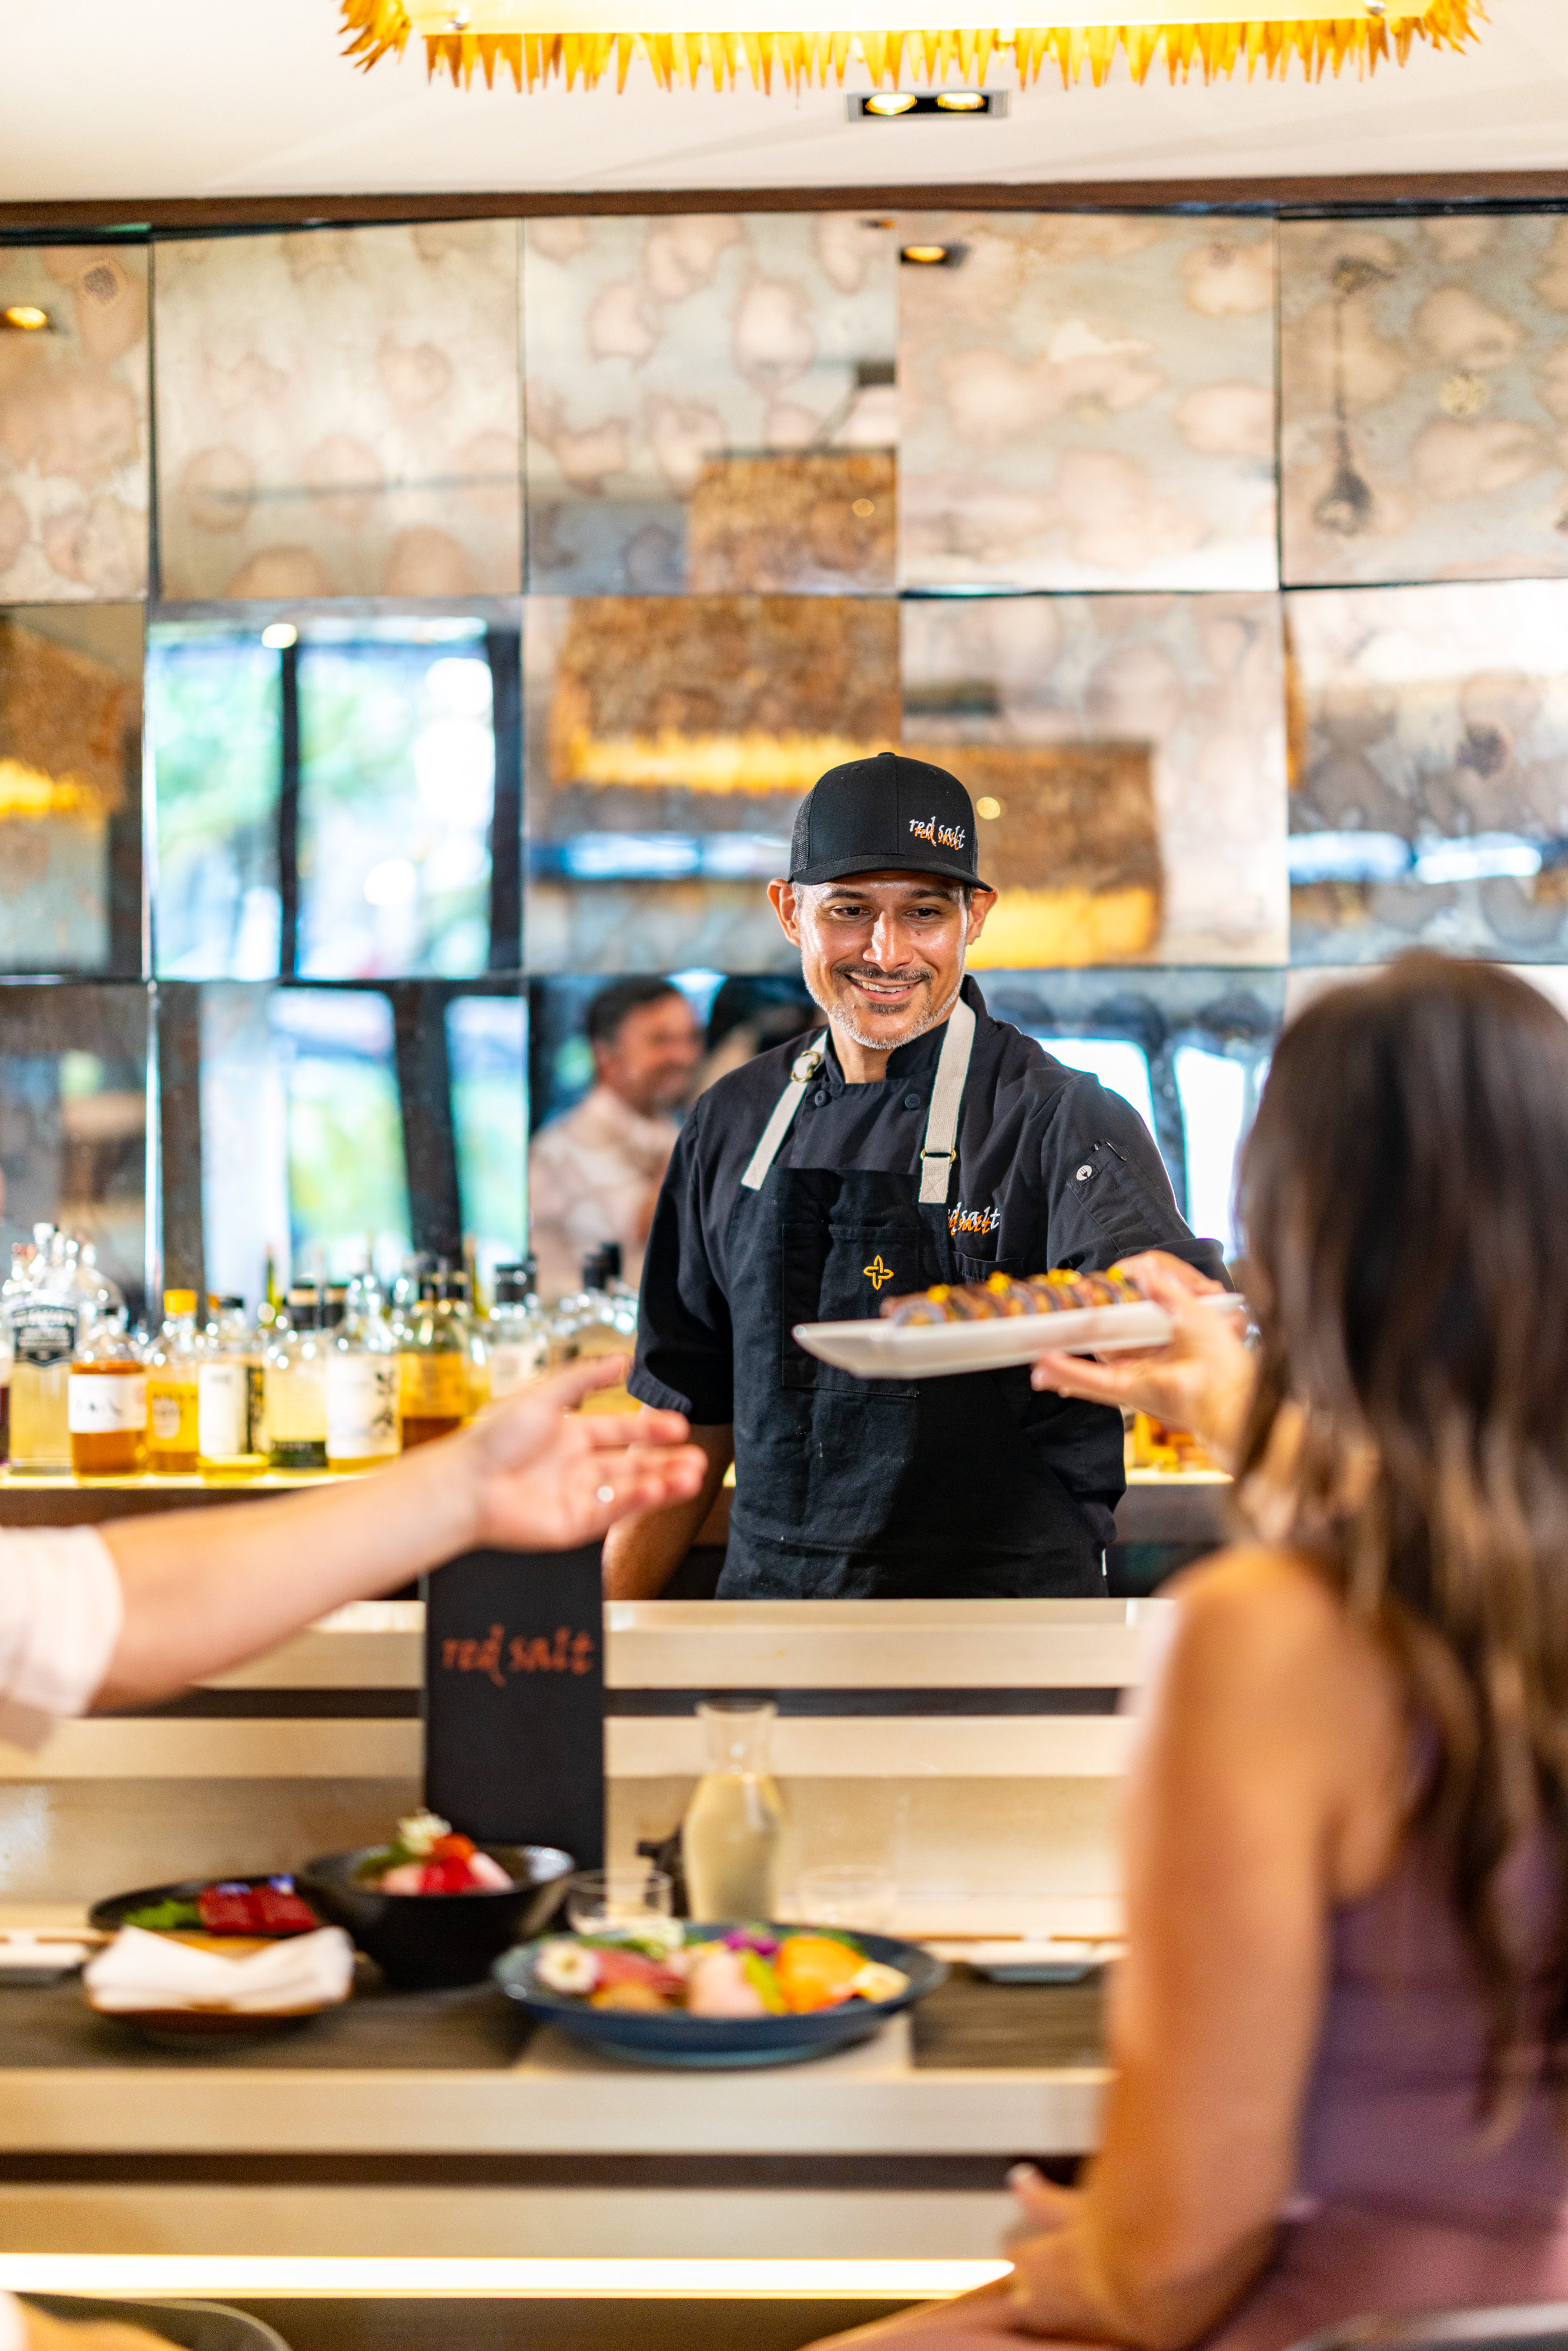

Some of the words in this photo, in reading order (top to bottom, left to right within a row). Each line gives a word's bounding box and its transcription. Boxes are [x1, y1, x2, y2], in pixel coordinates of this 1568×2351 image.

[909, 816, 937, 846] red
[938, 825, 966, 850] salt
[957, 1206, 1000, 1234] salt
[442, 1623, 506, 1687] red
[508, 1625, 594, 1675] salt
